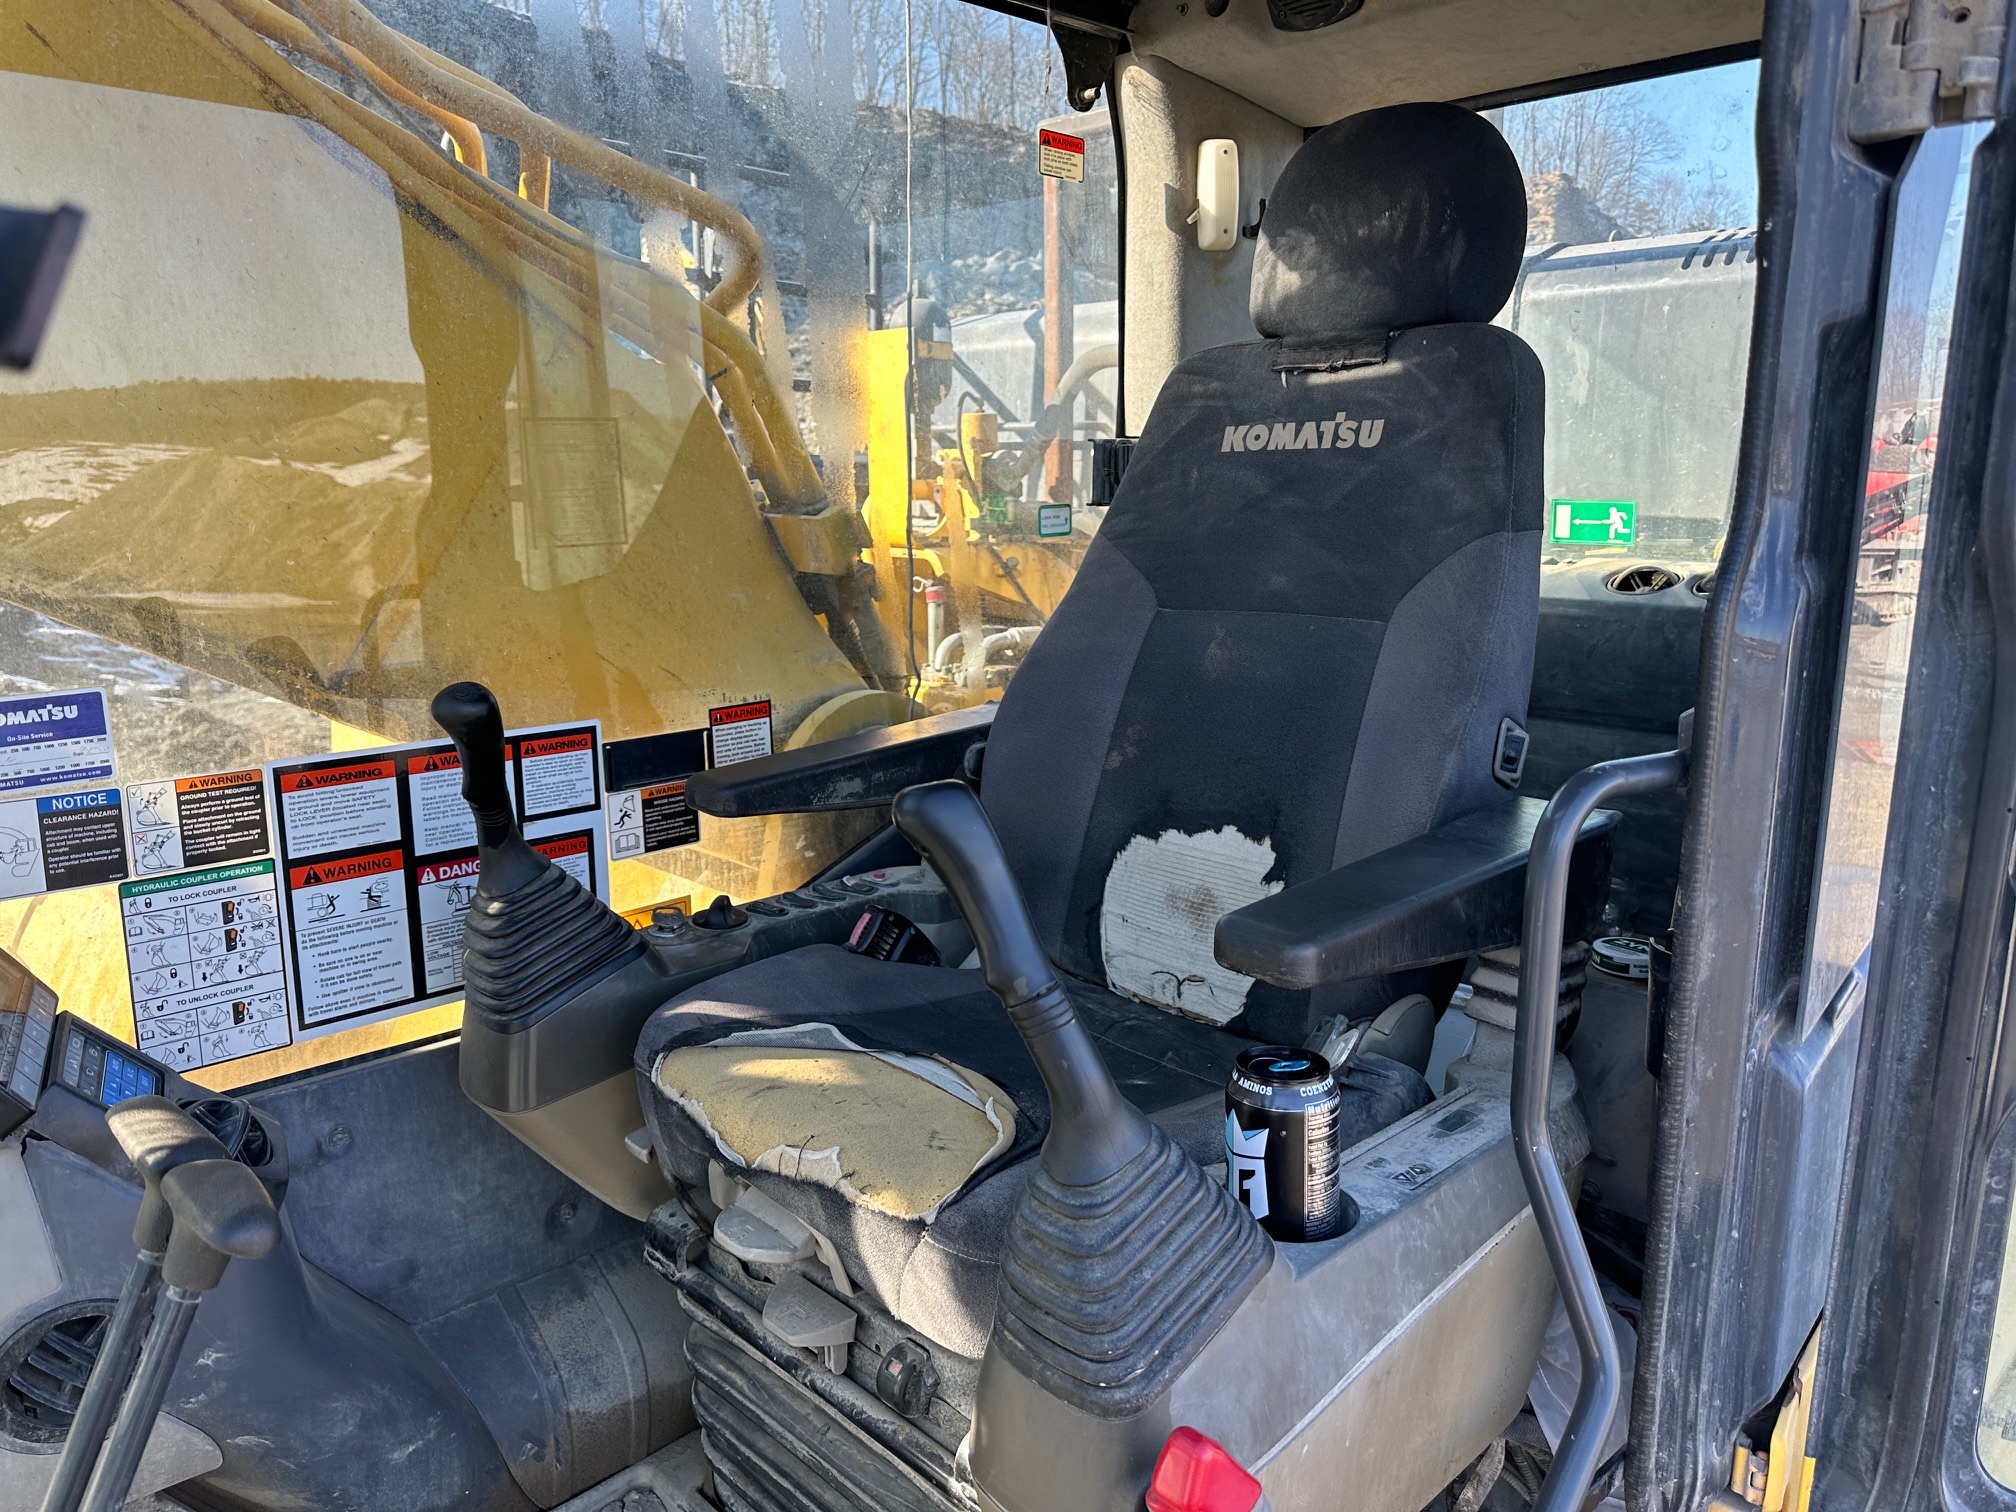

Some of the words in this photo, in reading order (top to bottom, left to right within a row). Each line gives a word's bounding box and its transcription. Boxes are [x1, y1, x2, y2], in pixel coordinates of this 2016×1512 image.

[1051, 135, 1082, 150] WARNING
[1221, 412, 1385, 452] KOMATSU
[0, 704, 78, 726] OMATSU
[725, 706, 767, 719] WARNING
[538, 738, 588, 752] WARNING
[40, 770, 101, 782] www.komatsu.com
[199, 773, 252, 787] WARNING
[315, 768, 382, 784] WARNING
[224, 786, 256, 794] REQUIRED!
[359, 787, 390, 795] equipment
[655, 784, 685, 795] WARNIN
[52, 793, 107, 810] NOTICE
[332, 803, 356, 812] (located
[366, 804, 391, 812] standing
[43, 813, 87, 824] CLEARANCE
[88, 809, 119, 818] HAZARD!
[316, 817, 347, 826] operator's
[538, 841, 586, 855] ARNING
[323, 857, 392, 879] WARNING
[439, 860, 480, 880] DANG
[132, 879, 179, 894] HYDRAULIC
[180, 873, 218, 885] COUPLER
[220, 865, 263, 878] OPERATION
[180, 892, 201, 901] LOCK
[203, 886, 237, 898] COUPLER
[308, 929, 326, 938] prevent
[346, 921, 363, 929] INJURY
[348, 944, 360, 952] alert
[360, 941, 376, 949] people
[377, 937, 393, 946] nearby.
[188, 992, 219, 1004] UNLOCK
[220, 984, 254, 999] COUPLER
[1238, 1077, 1273, 1096] AMINOS
[1308, 1126, 1330, 1137] Calories
